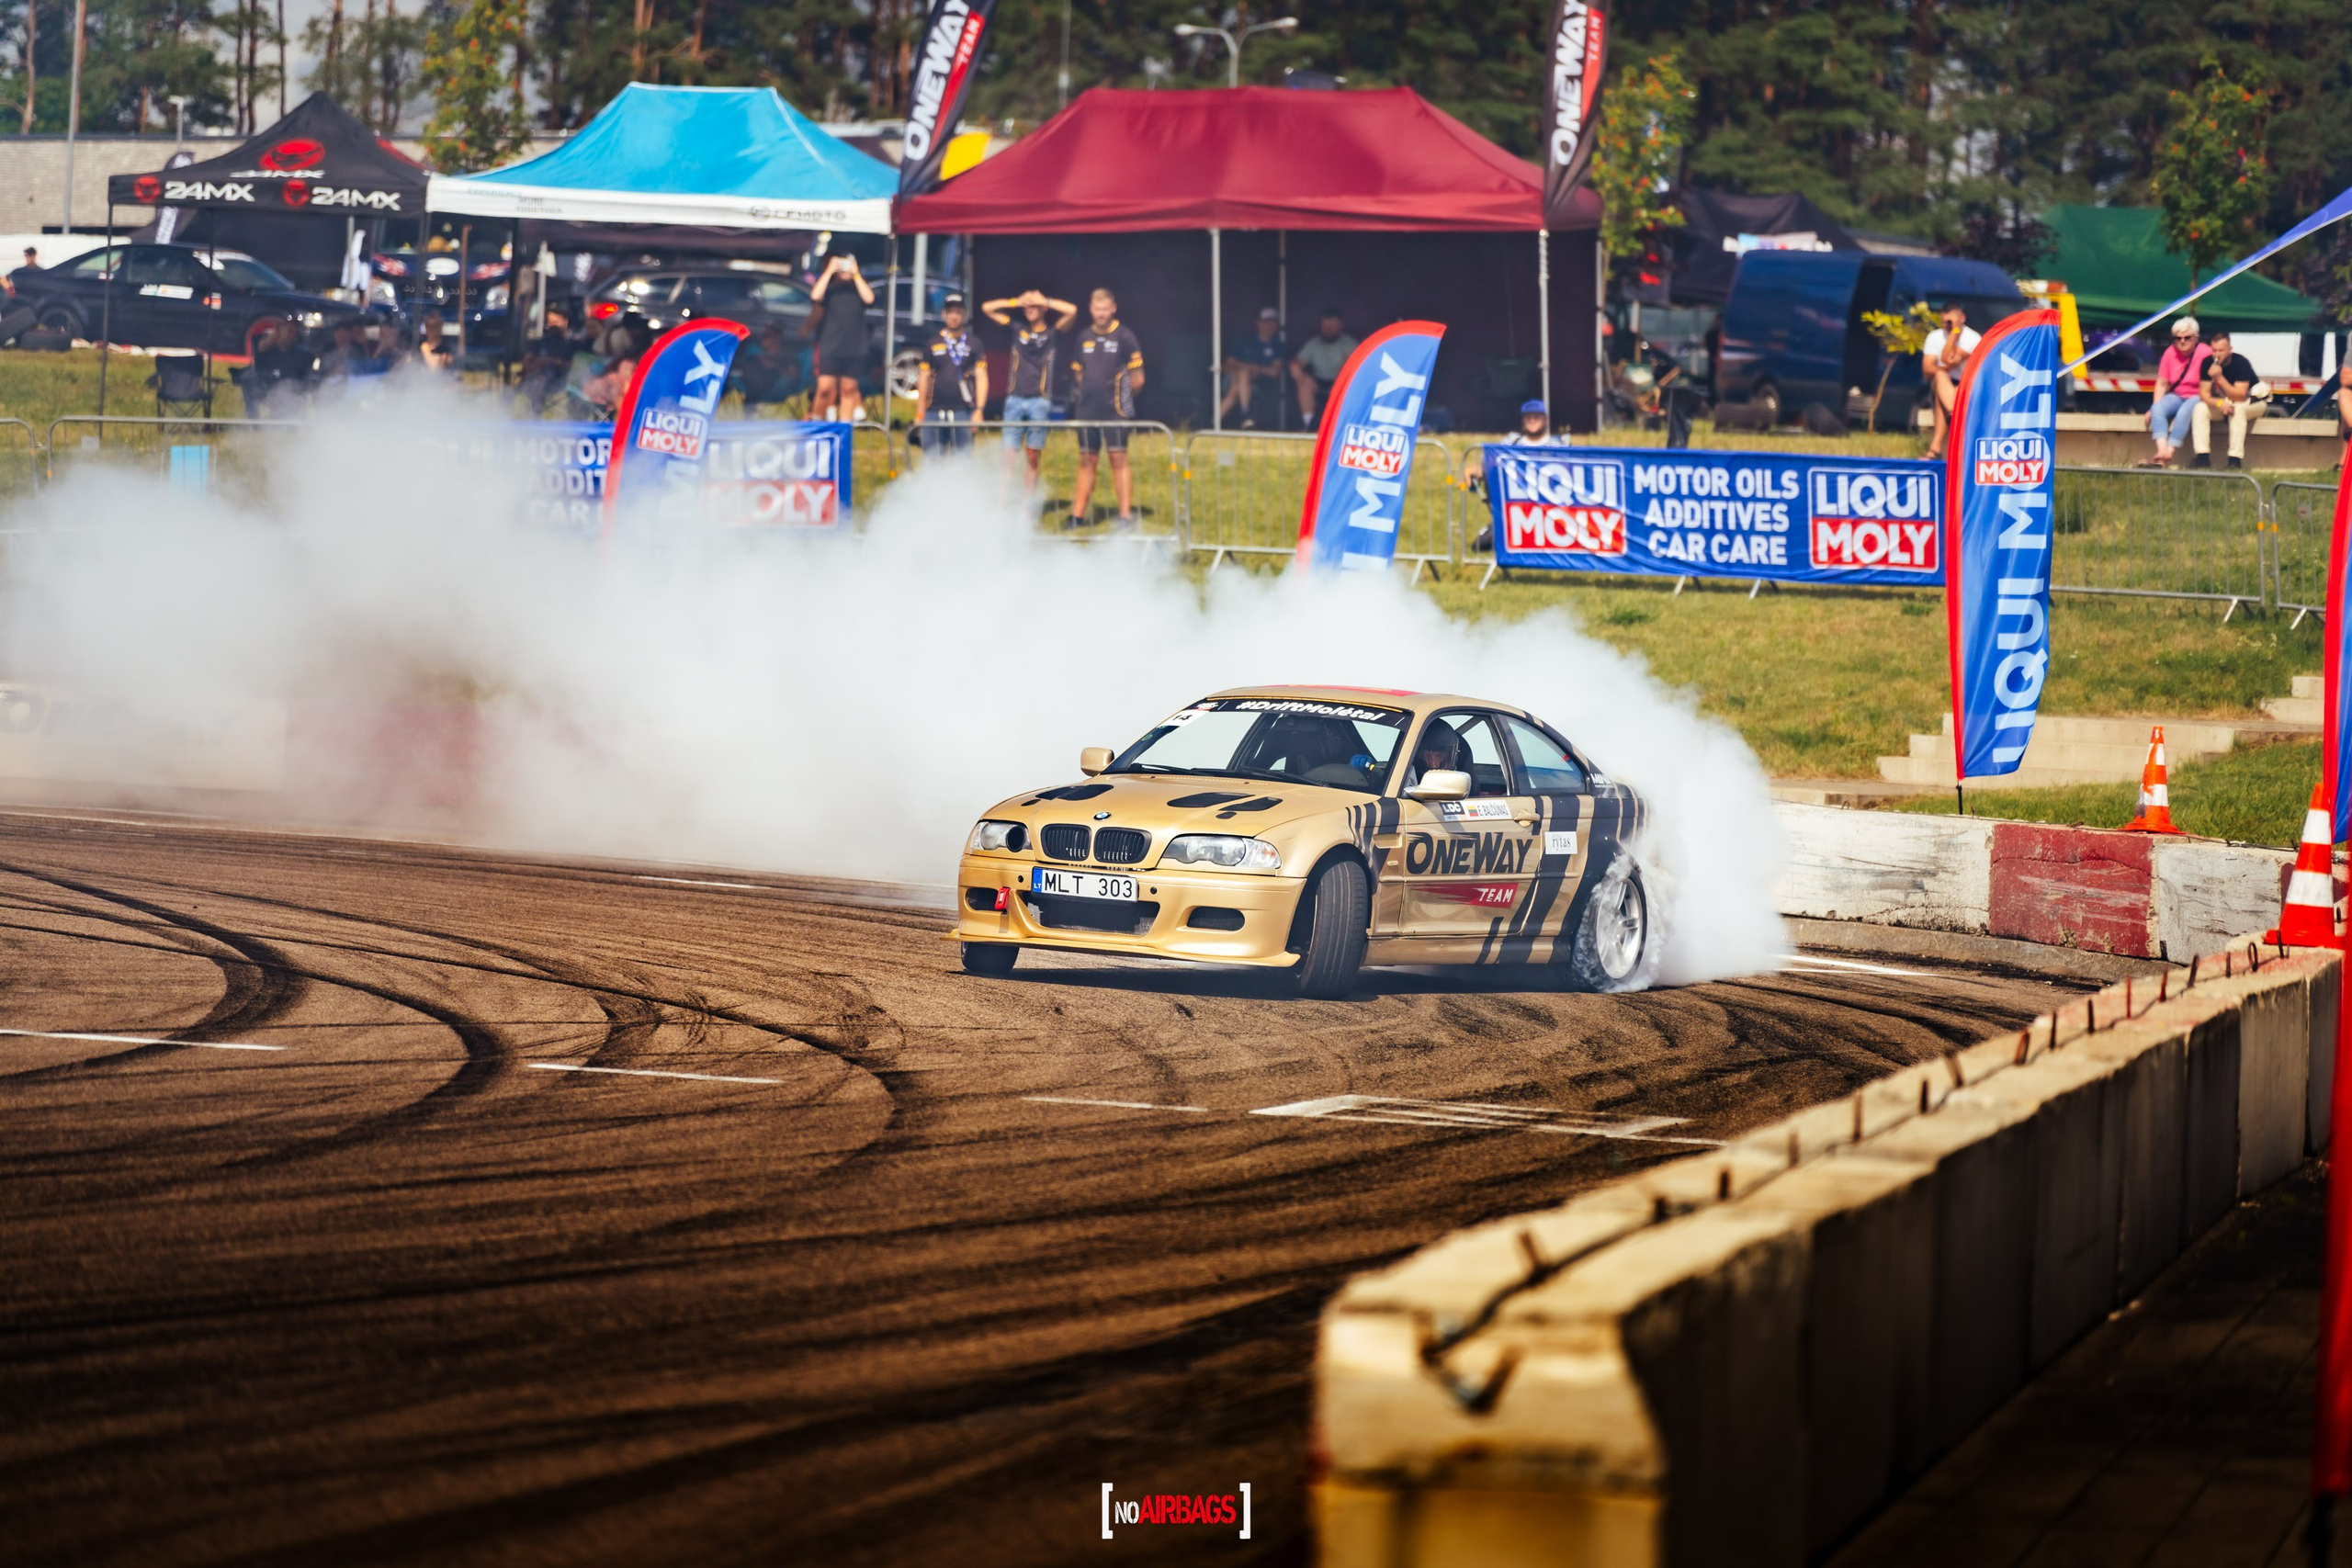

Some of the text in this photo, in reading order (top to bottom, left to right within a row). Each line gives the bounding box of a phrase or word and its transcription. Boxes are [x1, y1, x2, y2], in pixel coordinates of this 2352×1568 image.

[958, 18, 980, 63] TEAM
[1588, 17, 1601, 61] TEAM
[164, 181, 255, 202] 24MX
[311, 186, 401, 211] 24MX
[646, 411, 701, 435] LIQUI
[641, 430, 698, 456] MOLY
[1347, 426, 1406, 454] LIQUI
[1979, 439, 2042, 461] LIQUI
[708, 439, 831, 480] LIQUI
[1342, 447, 1402, 474] MOLY
[1979, 462, 2042, 483] MOLY
[1505, 460, 1618, 507] LIQUI
[1634, 464, 1801, 500] MOTOR OILS
[1815, 473, 1930, 519] LIQUI
[706, 483, 834, 523] MOLY
[1644, 497, 1791, 533] ADDITIVES
[1510, 505, 1623, 550] MOLY
[1648, 530, 1788, 566] CAR CARE
[1817, 522, 1935, 566] MOLY
[1993, 578, 2048, 763] LIQUI
[1442, 803, 1462, 813] LDC
[1553, 837, 1571, 851] rytas
[1045, 872, 1133, 898] MLT 303
[1476, 887, 1514, 903] TEAM
